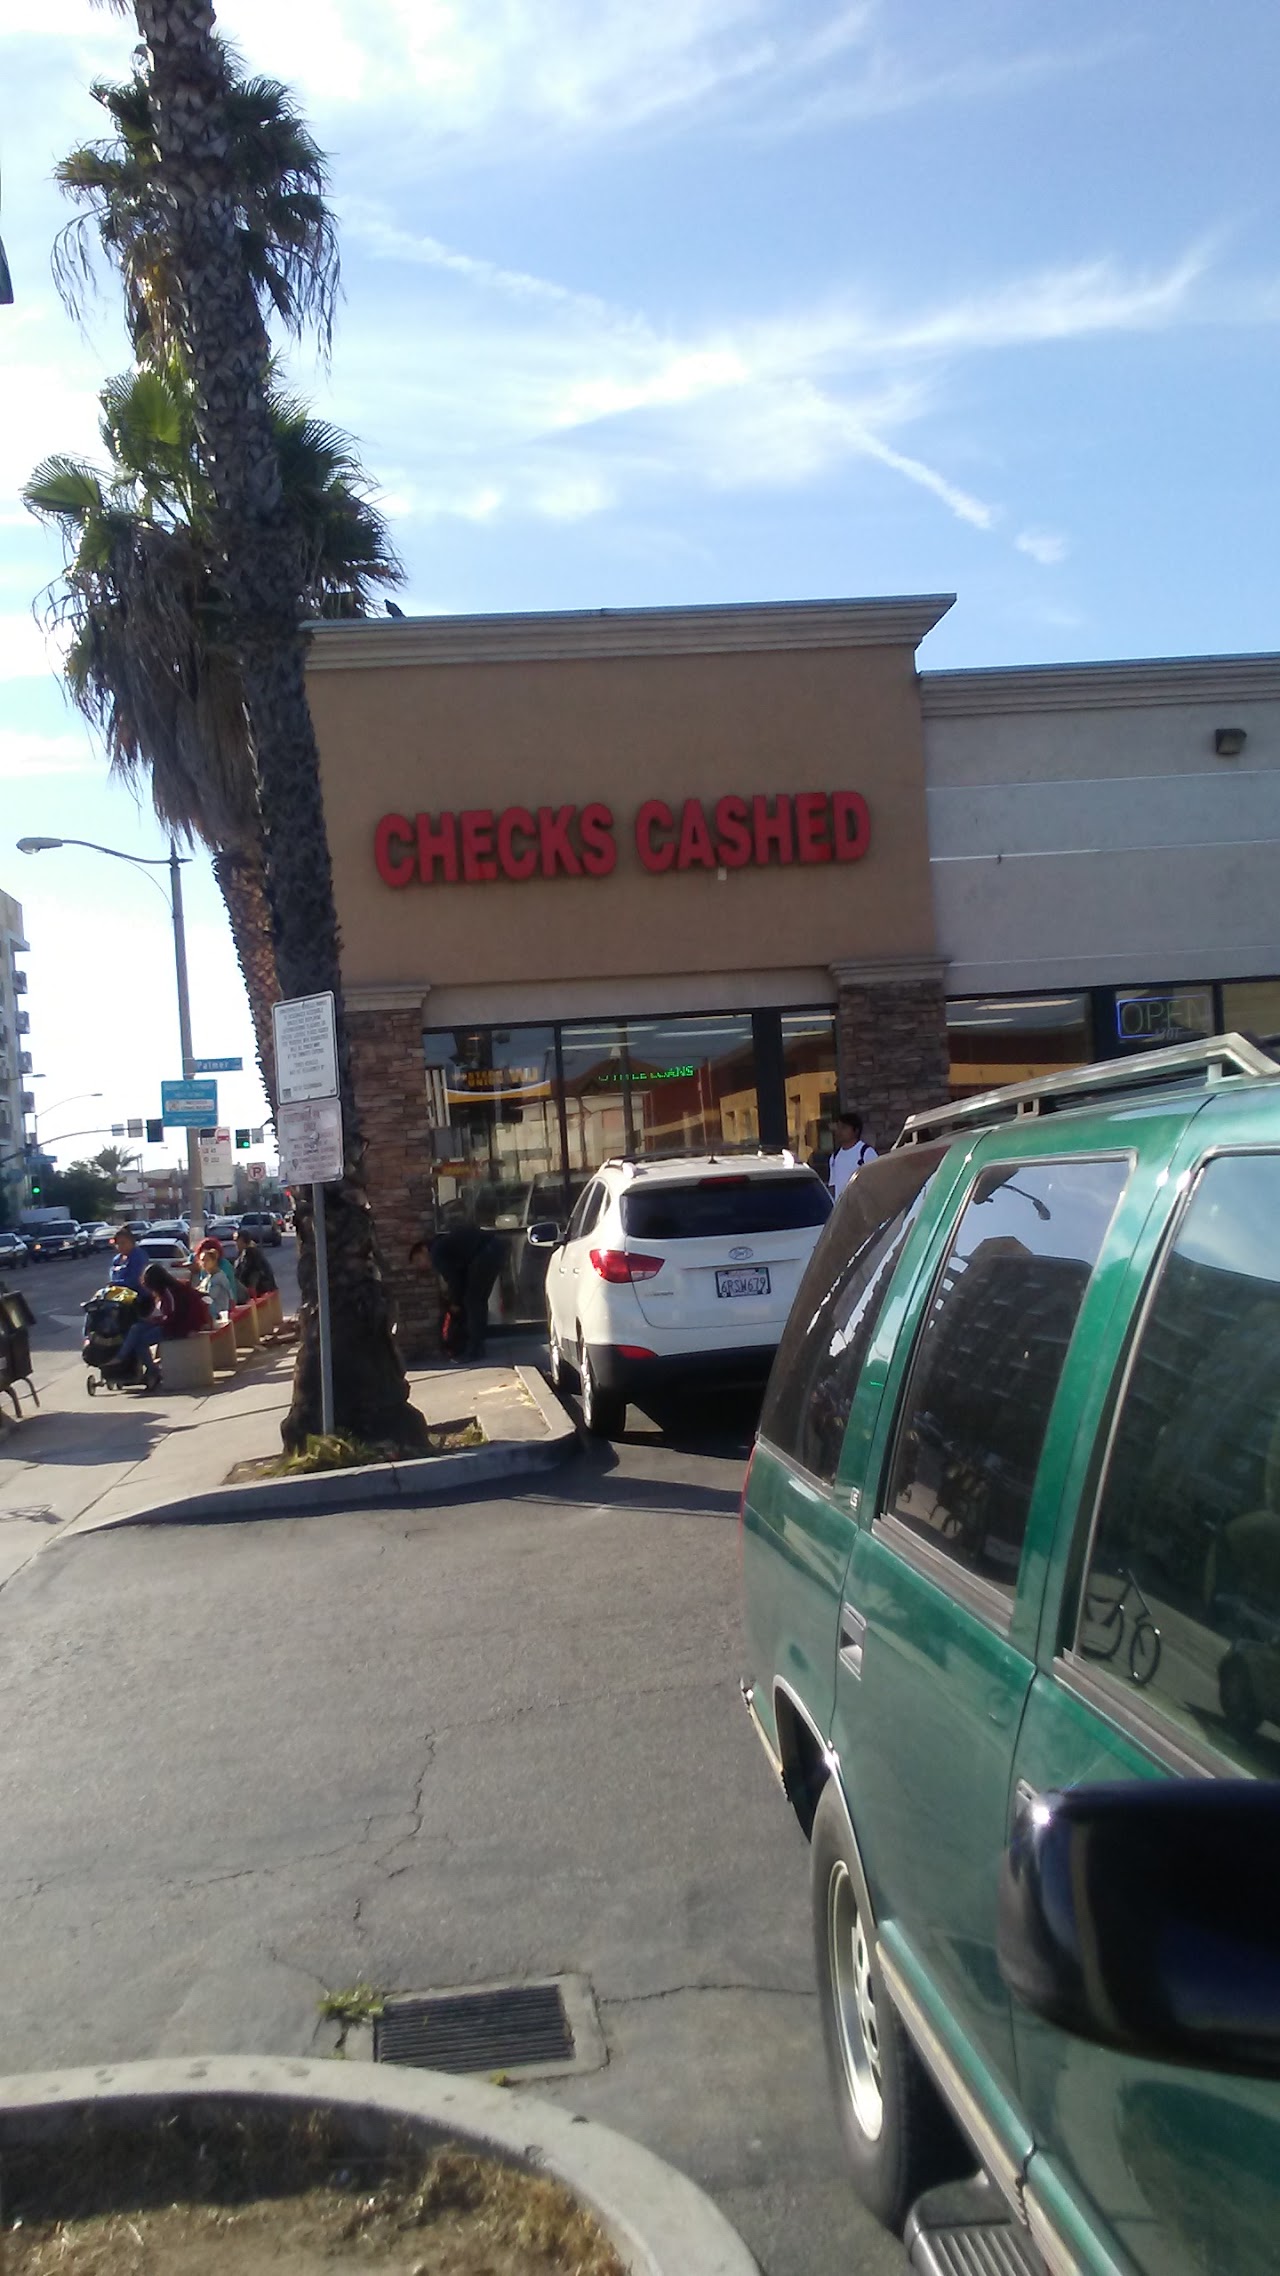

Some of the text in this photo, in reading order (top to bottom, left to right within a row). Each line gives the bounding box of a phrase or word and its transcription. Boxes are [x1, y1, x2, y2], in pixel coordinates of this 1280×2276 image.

[374, 791, 871, 887] CHECKS CASHED
[1122, 999, 1204, 1034] OPEN
[196, 1060, 229, 1070] Palmer
